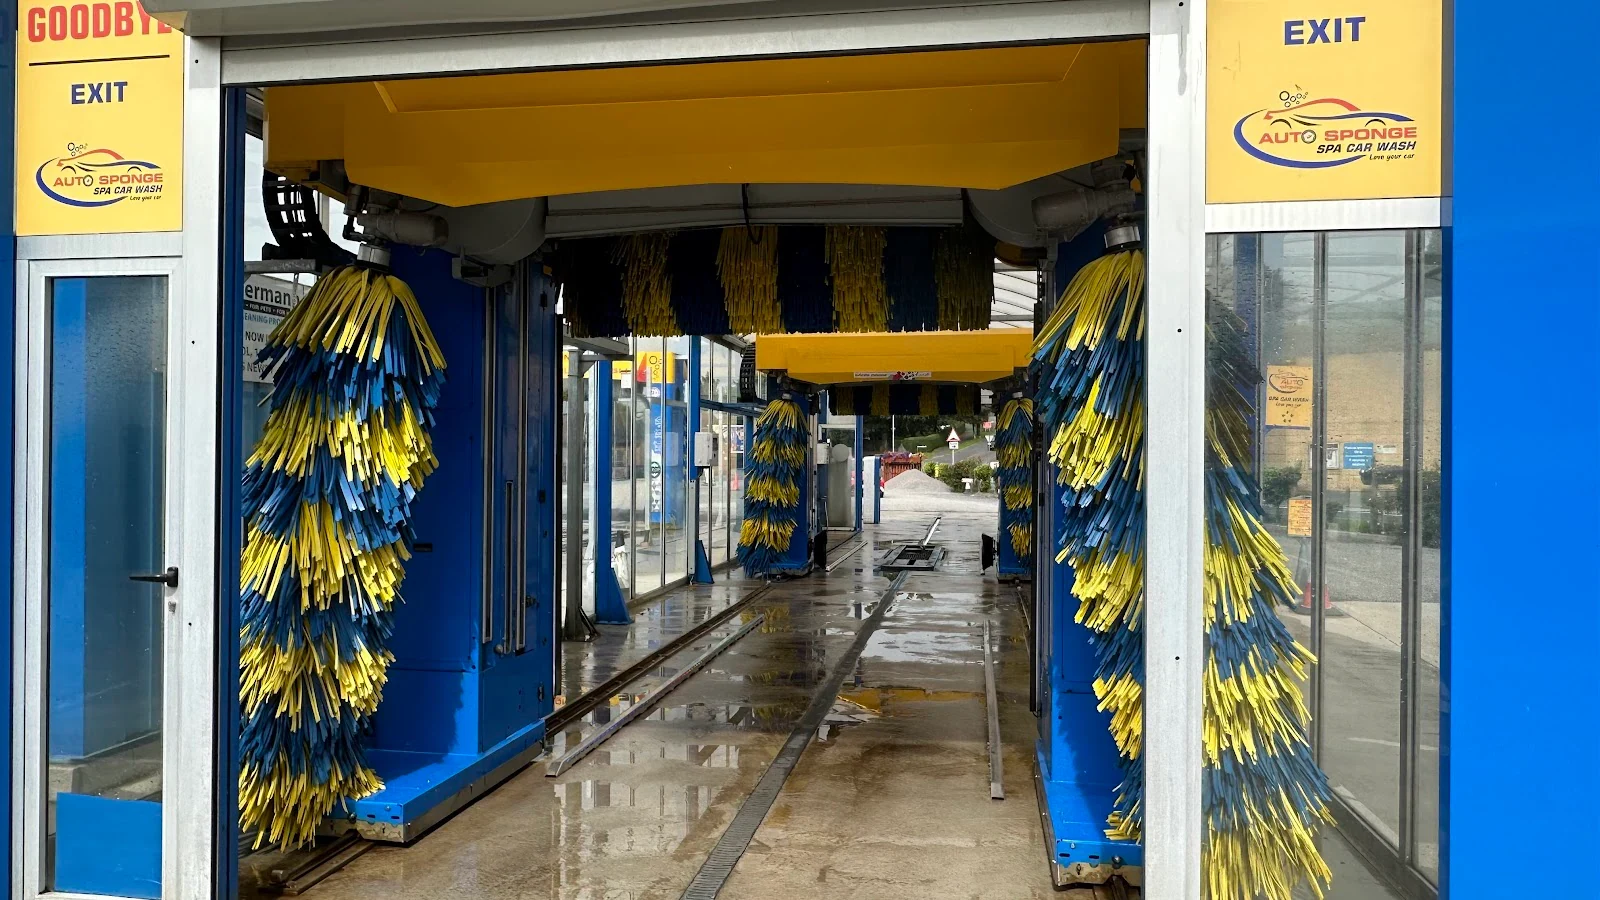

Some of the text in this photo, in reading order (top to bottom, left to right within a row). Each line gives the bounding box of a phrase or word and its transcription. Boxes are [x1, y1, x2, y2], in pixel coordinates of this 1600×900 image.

[1284, 16, 1366, 46] EXIT
[71, 81, 128, 105] EXIT
[1258, 126, 1417, 145] AUTO SPONGE
[1316, 141, 1417, 154] SPA CAR WASH
[1386, 154, 1402, 162] your
[53, 173, 163, 187] AUTO SPONGE
[93, 184, 163, 195] SPA CAR WASH
[245, 284, 299, 307] erman
[245, 331, 264, 343] NOW
